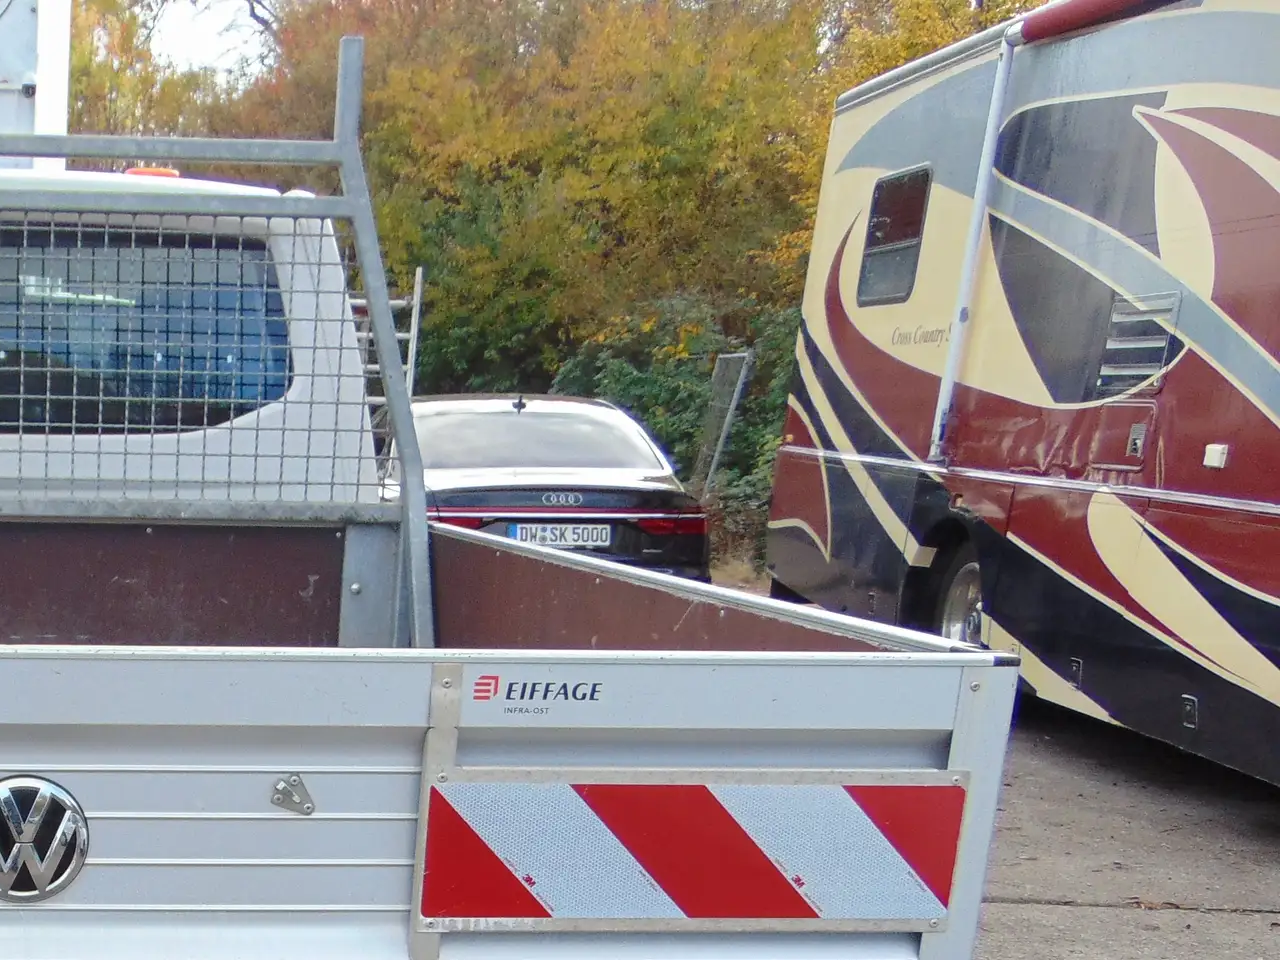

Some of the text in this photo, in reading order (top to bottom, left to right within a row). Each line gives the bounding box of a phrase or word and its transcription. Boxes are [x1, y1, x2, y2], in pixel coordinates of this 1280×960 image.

[891, 326, 912, 345] Cross
[913, 325, 946, 348] Country
[519, 526, 609, 543] DW SK 5000
[505, 682, 603, 701] EIFFAGE
[503, 706, 550, 715] INFRA-OST
[522, 873, 537, 888] 3M
